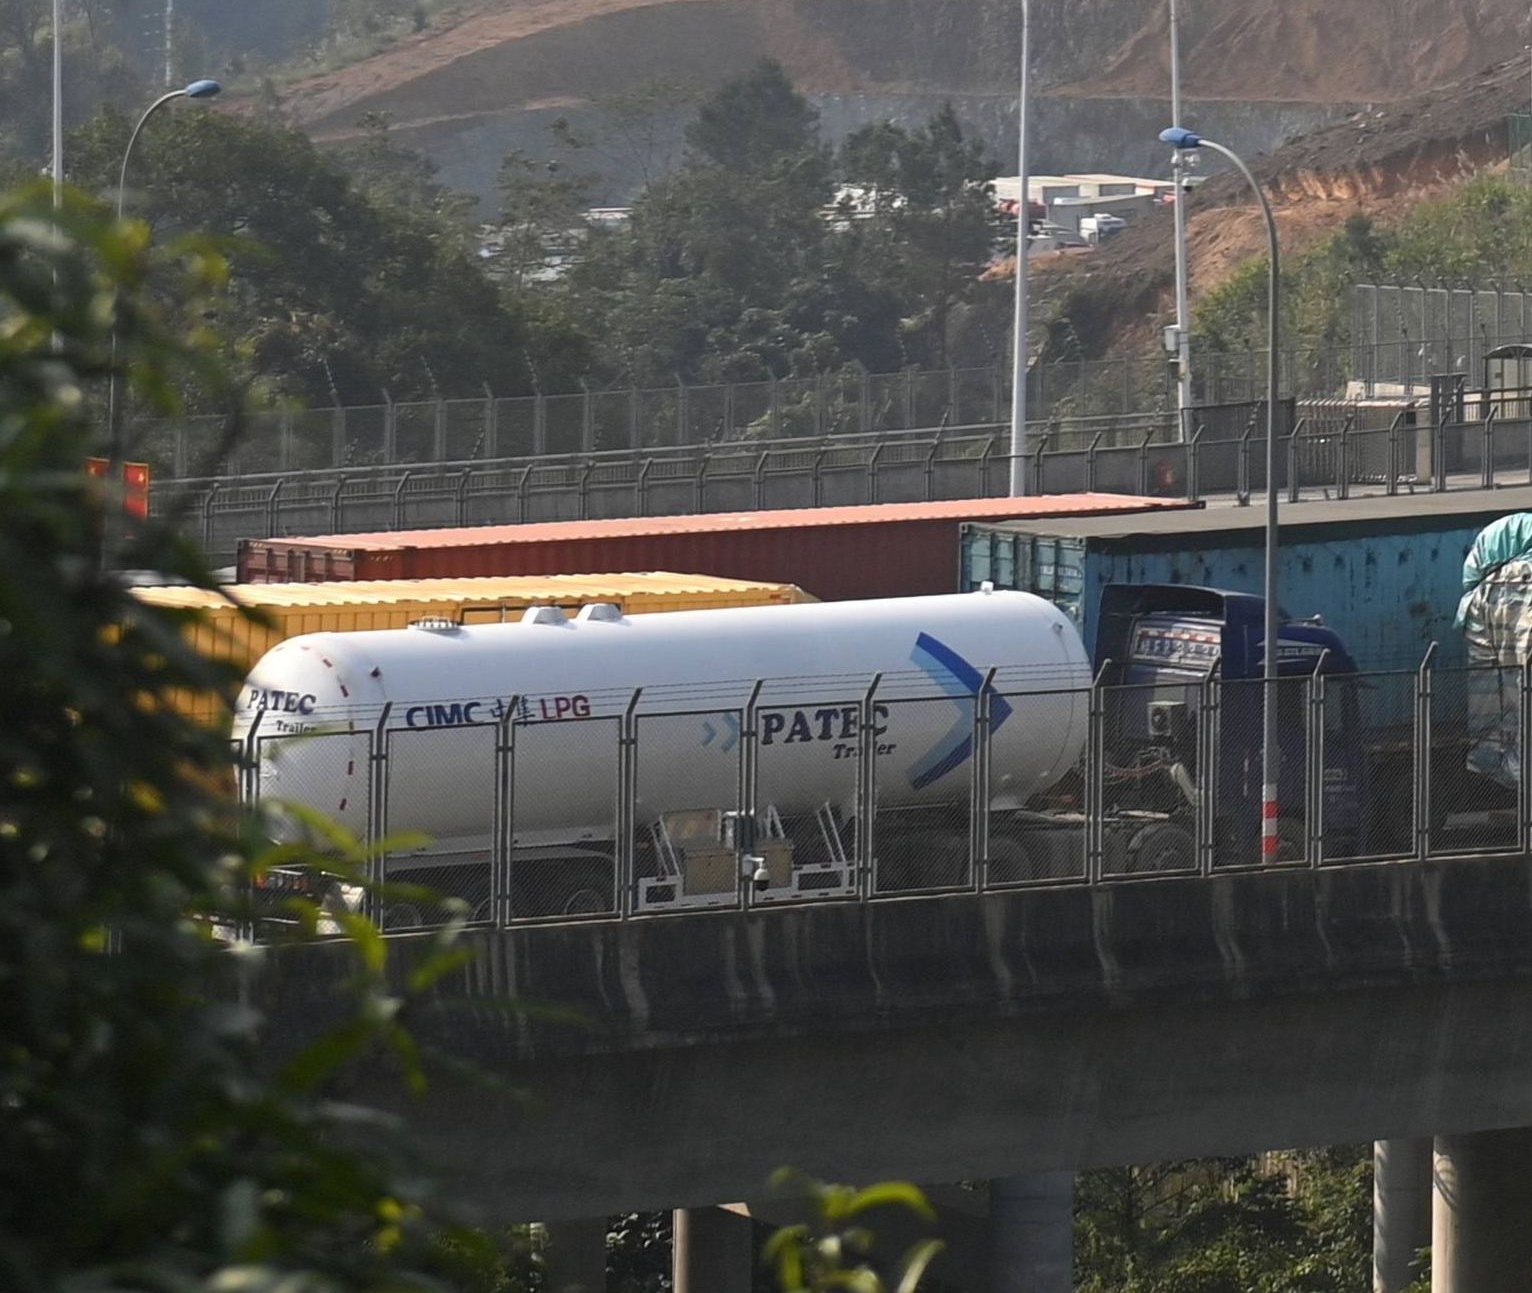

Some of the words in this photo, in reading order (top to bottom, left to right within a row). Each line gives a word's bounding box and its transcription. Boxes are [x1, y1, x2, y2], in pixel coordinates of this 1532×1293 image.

[246, 689, 316, 715] PATEC
[405, 702, 482, 729] CIMC
[540, 695, 591, 720] LPG
[832, 743, 897, 760] Trer
